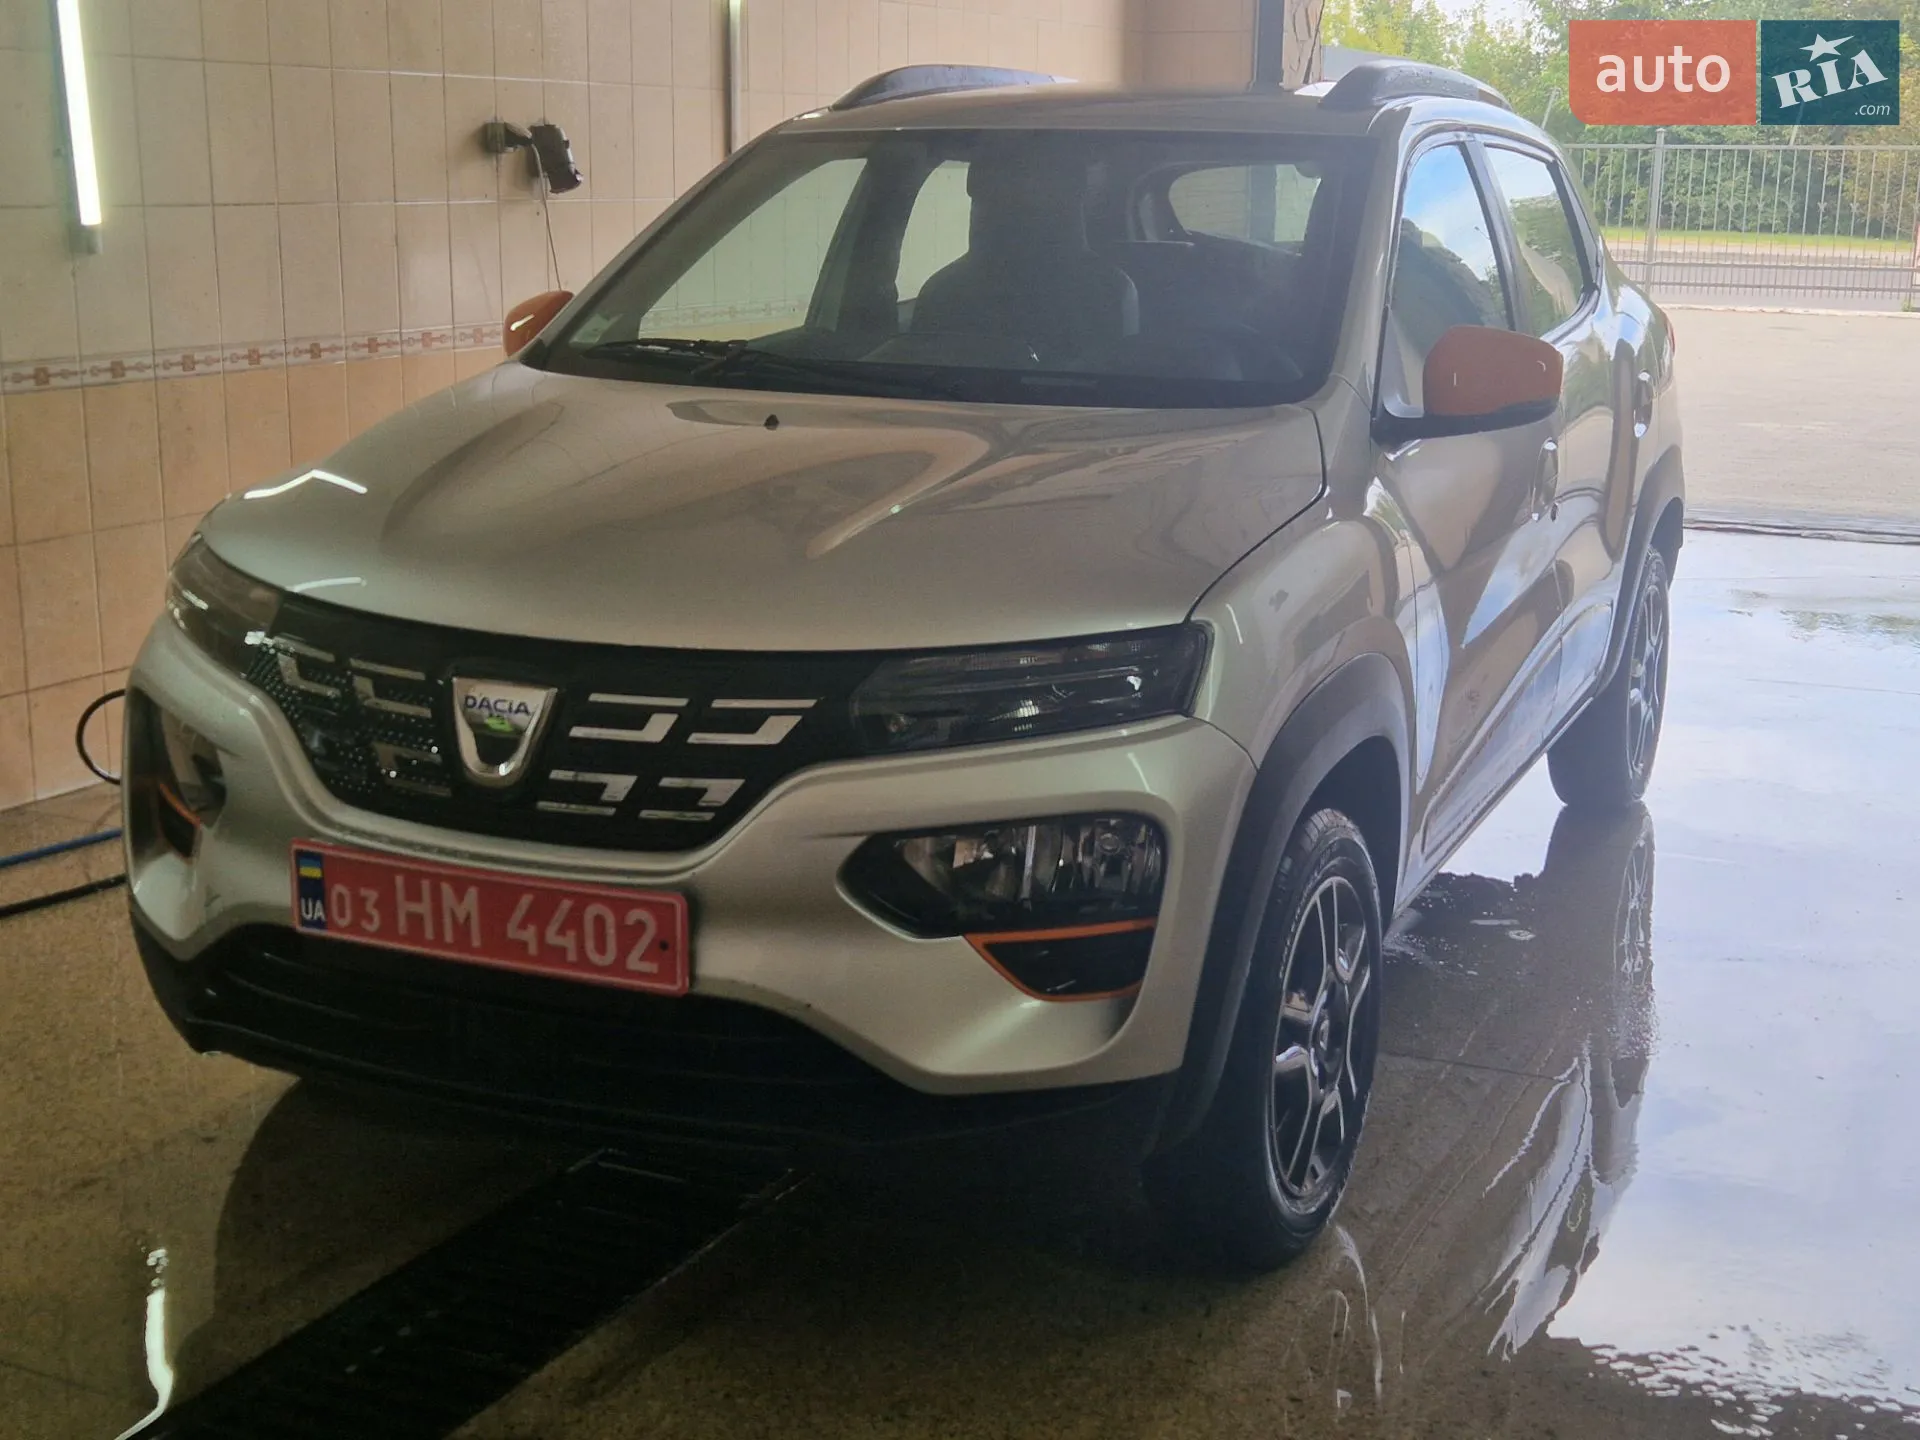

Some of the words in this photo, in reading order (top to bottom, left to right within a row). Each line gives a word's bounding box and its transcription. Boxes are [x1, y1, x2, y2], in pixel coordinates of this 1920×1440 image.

[464, 695, 531, 715] DACIA
[301, 897, 325, 921] UA
[330, 884, 380, 933] 03
[395, 875, 481, 948] HM
[507, 893, 659, 974] 4402
